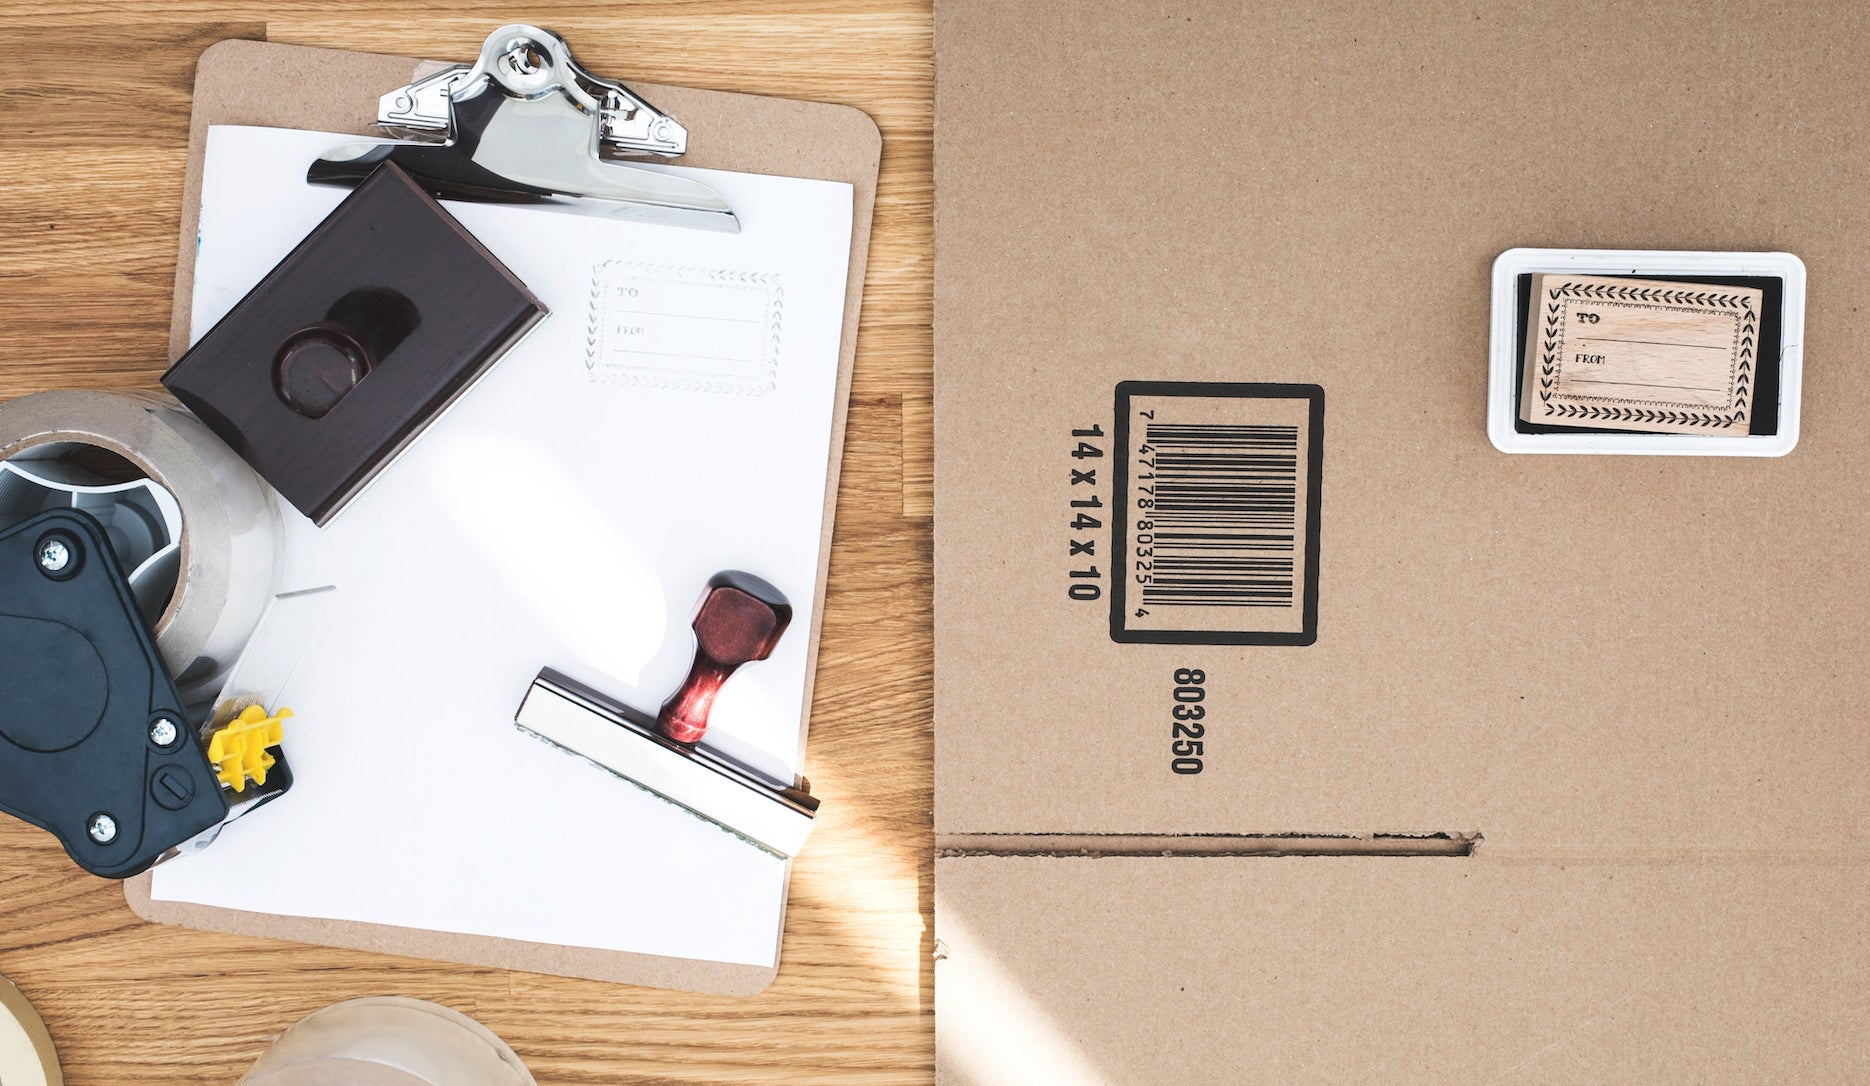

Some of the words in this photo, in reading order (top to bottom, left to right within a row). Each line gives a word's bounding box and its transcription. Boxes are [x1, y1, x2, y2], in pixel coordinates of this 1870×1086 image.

[617, 287, 639, 298] TO
[1576, 312, 1600, 324] TO
[1575, 353, 1606, 365] FROM
[1071, 423, 1104, 459] 14
[1071, 468, 1096, 485] x
[1137, 443, 1155, 509] 47178
[1070, 494, 1103, 530] 14
[1069, 539, 1095, 556] x
[1136, 520, 1154, 584] 80325
[1069, 565, 1102, 601] 10
[1171, 667, 1206, 775] 803250
